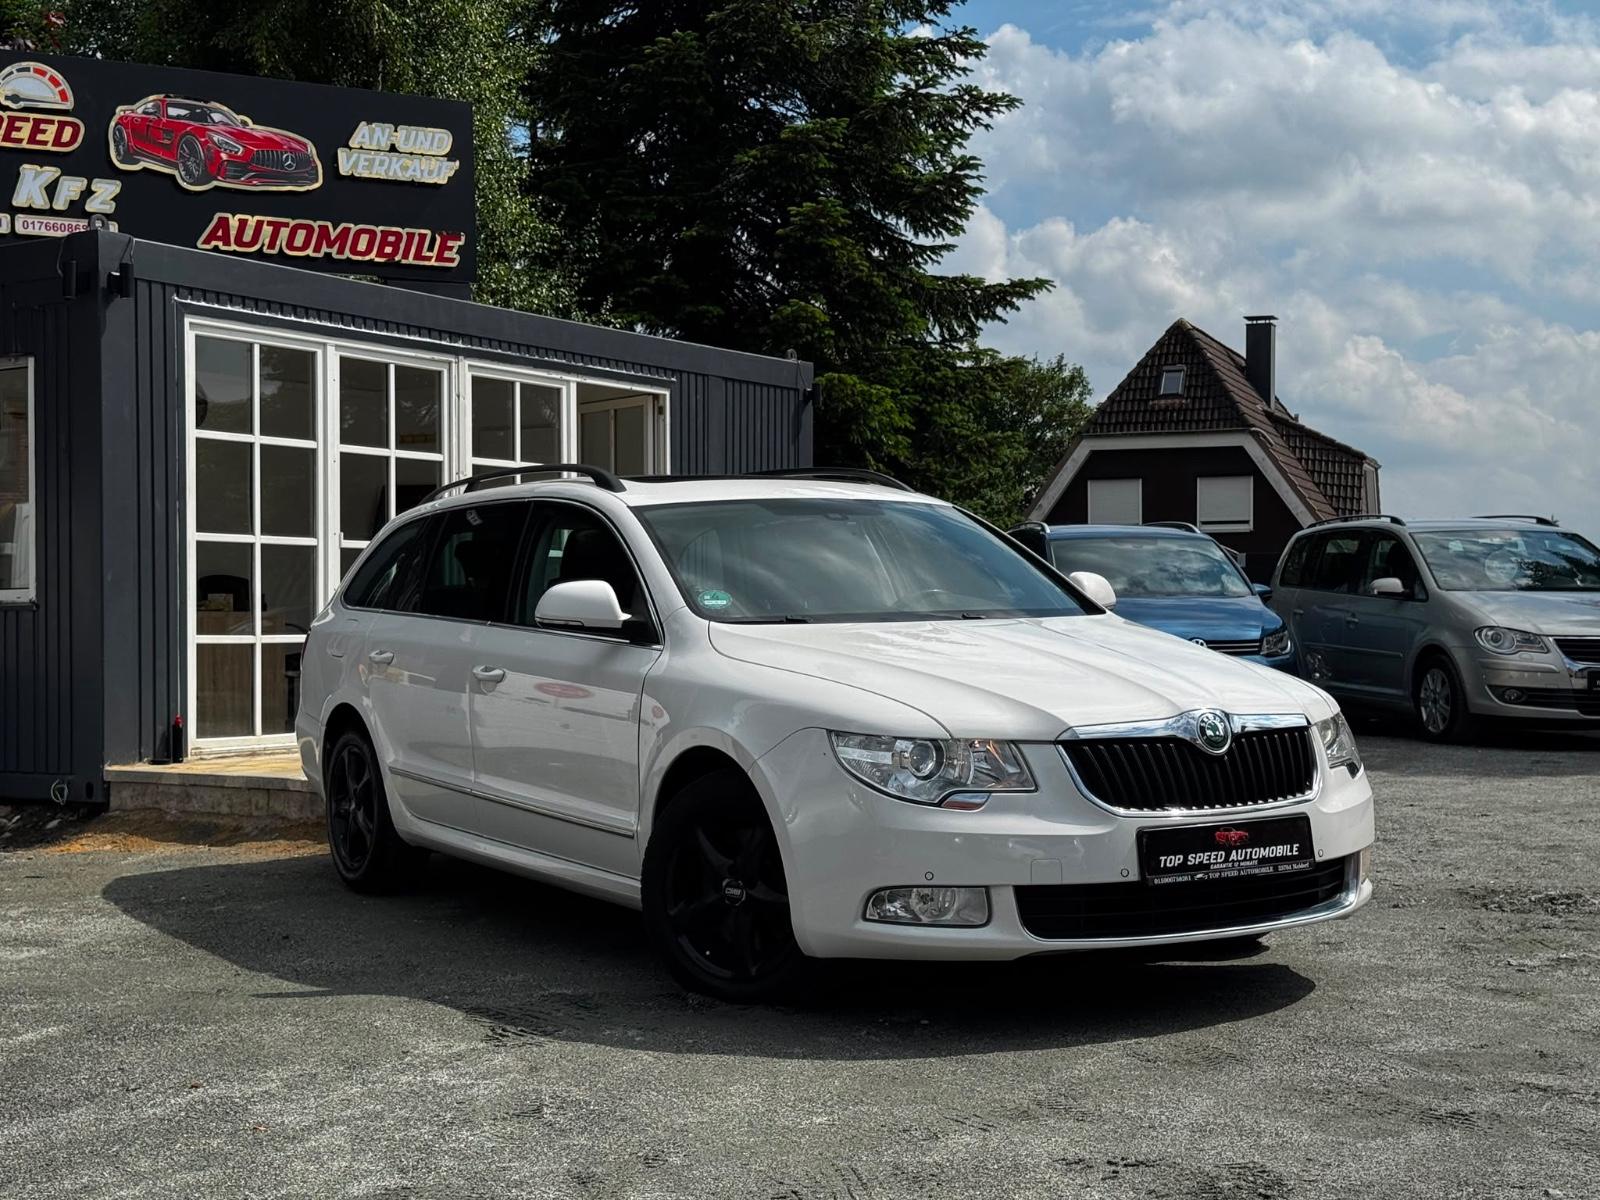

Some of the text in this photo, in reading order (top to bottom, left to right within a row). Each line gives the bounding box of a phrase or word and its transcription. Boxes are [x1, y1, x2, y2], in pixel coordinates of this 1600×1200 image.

[0, 115, 83, 150] EED
[339, 149, 457, 182] VERKAUF
[200, 215, 464, 265] AUTOMOBILE
[1160, 844, 1299, 868] TOP SPEED AUTOMOBILE
[1221, 870, 1239, 878] SPEED
[1240, 866, 1273, 875] AUTOMOBILE
